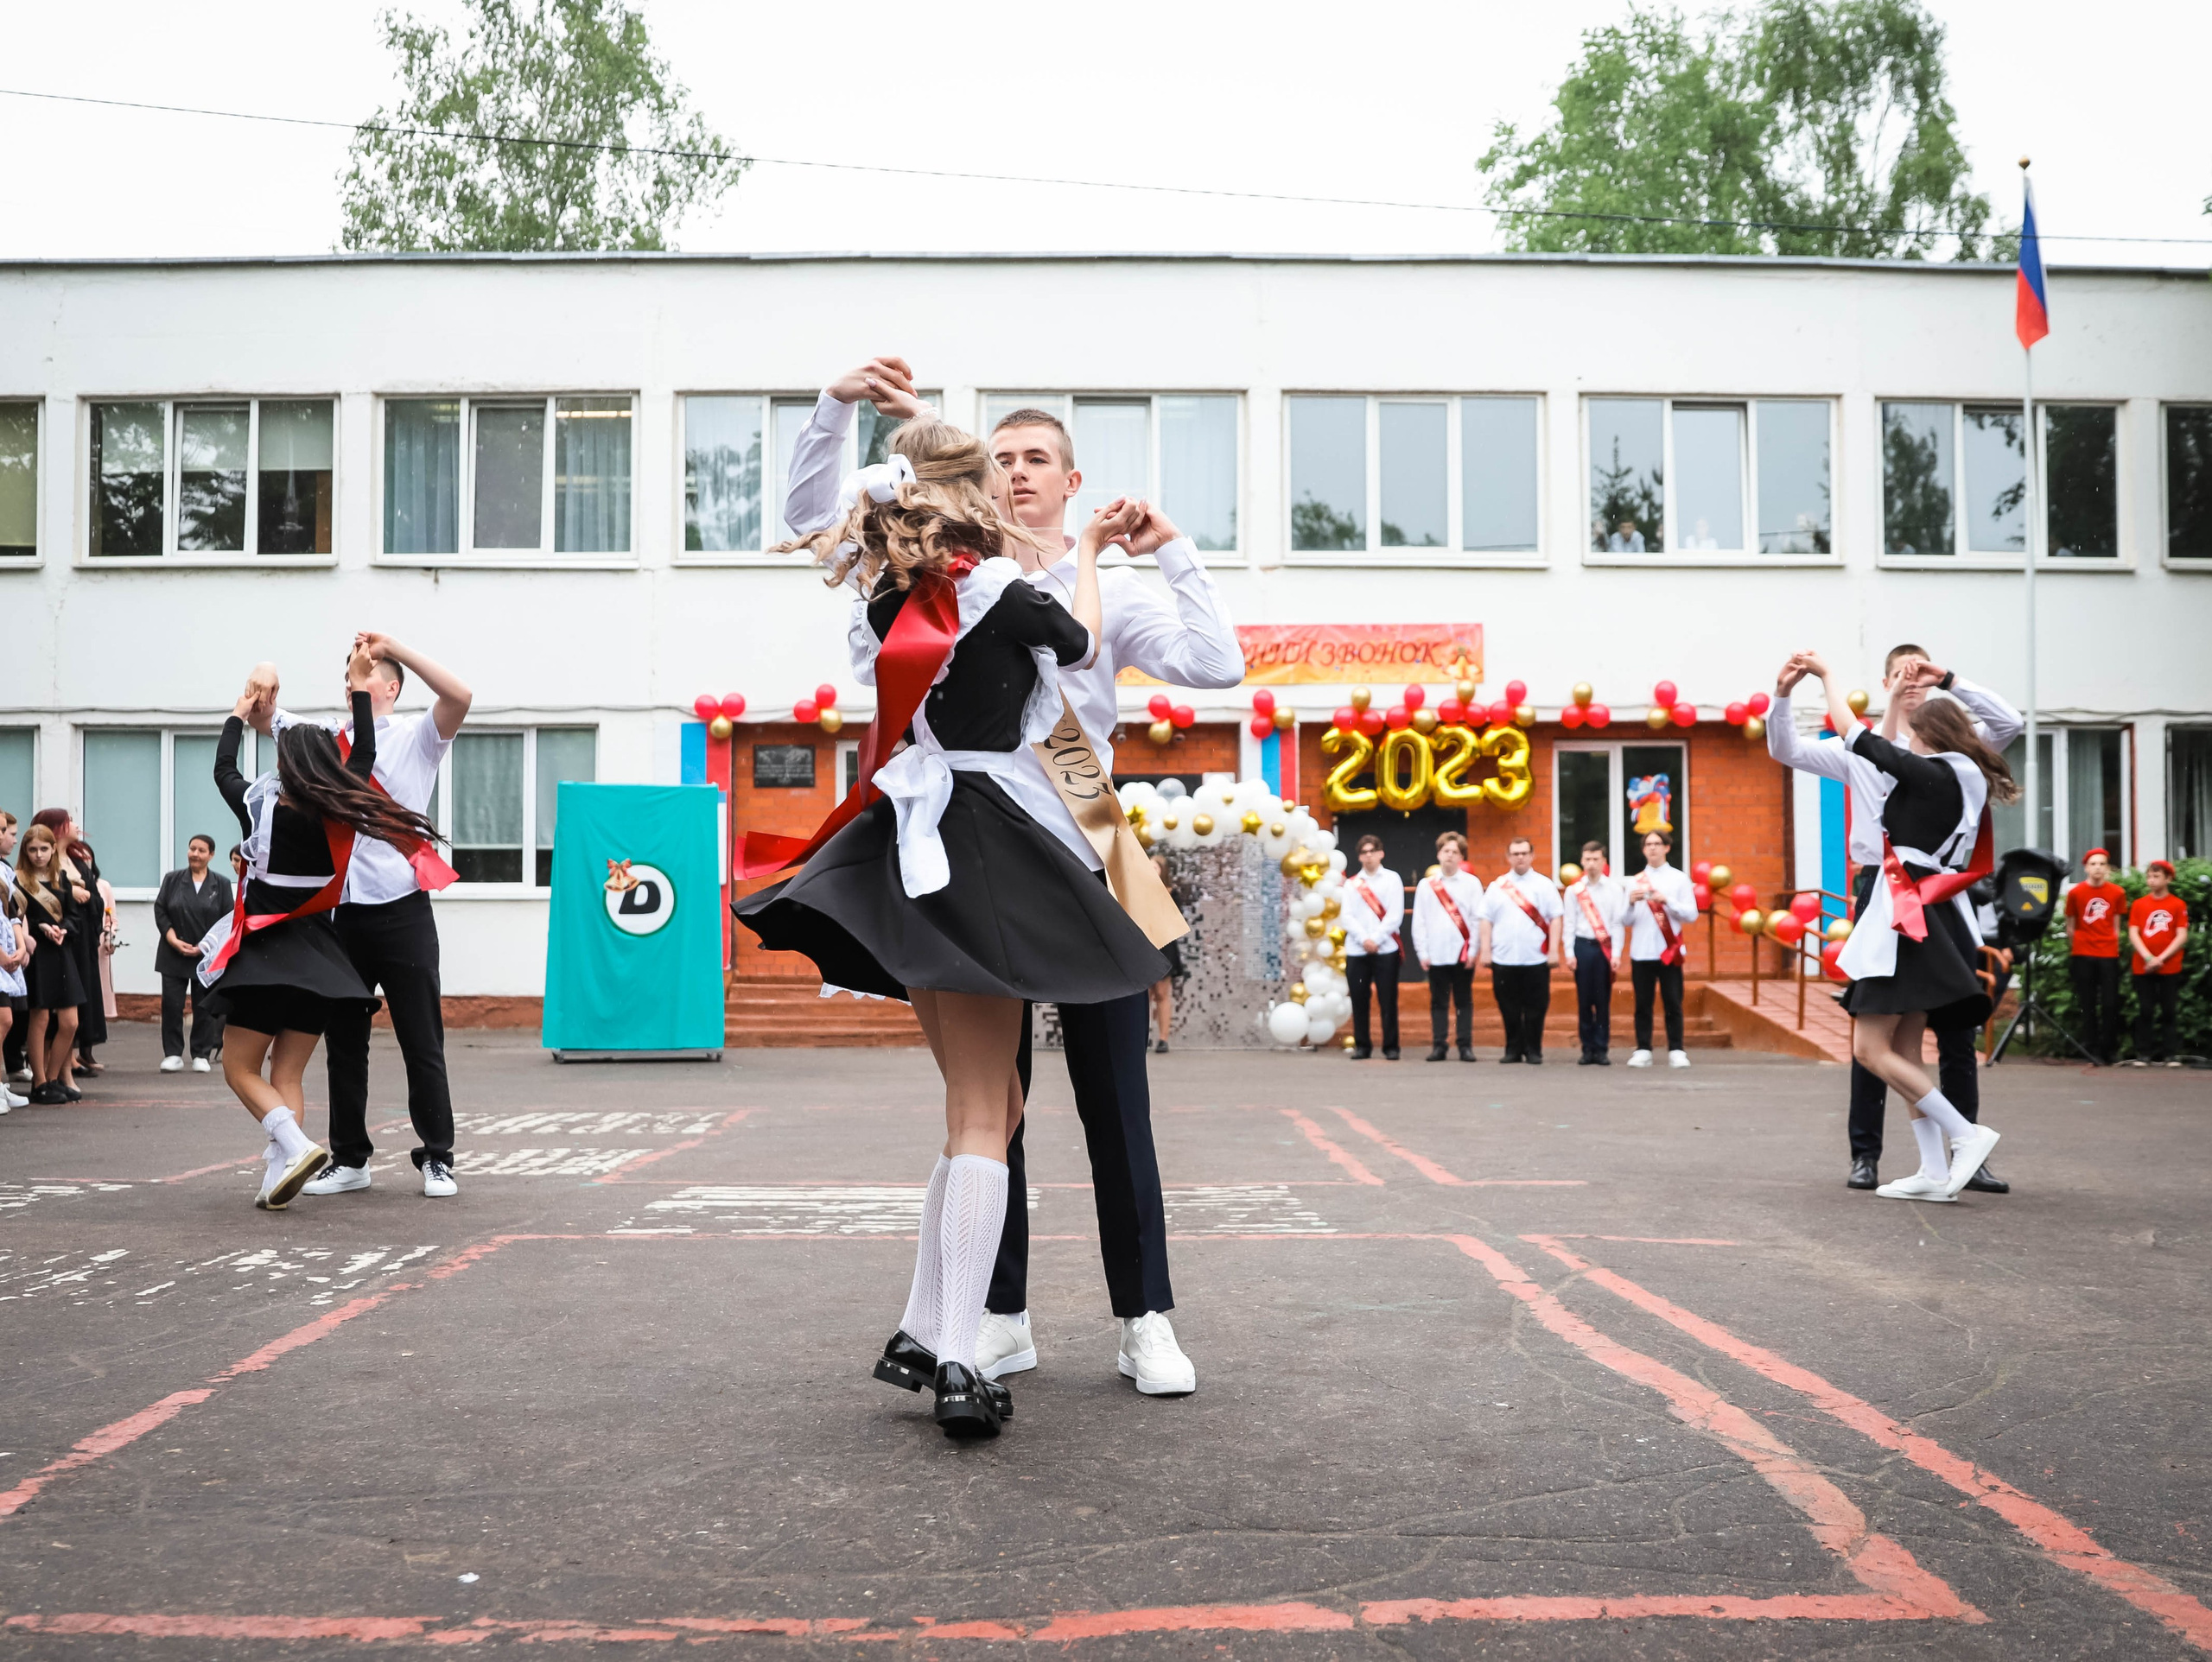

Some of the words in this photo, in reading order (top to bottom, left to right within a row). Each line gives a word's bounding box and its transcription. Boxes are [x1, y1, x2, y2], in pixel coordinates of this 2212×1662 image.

[1319, 639, 1446, 668] ЗВОНОК
[1044, 728, 1112, 799] 2023
[1321, 725, 1535, 811] 2023
[619, 880, 661, 915] D
